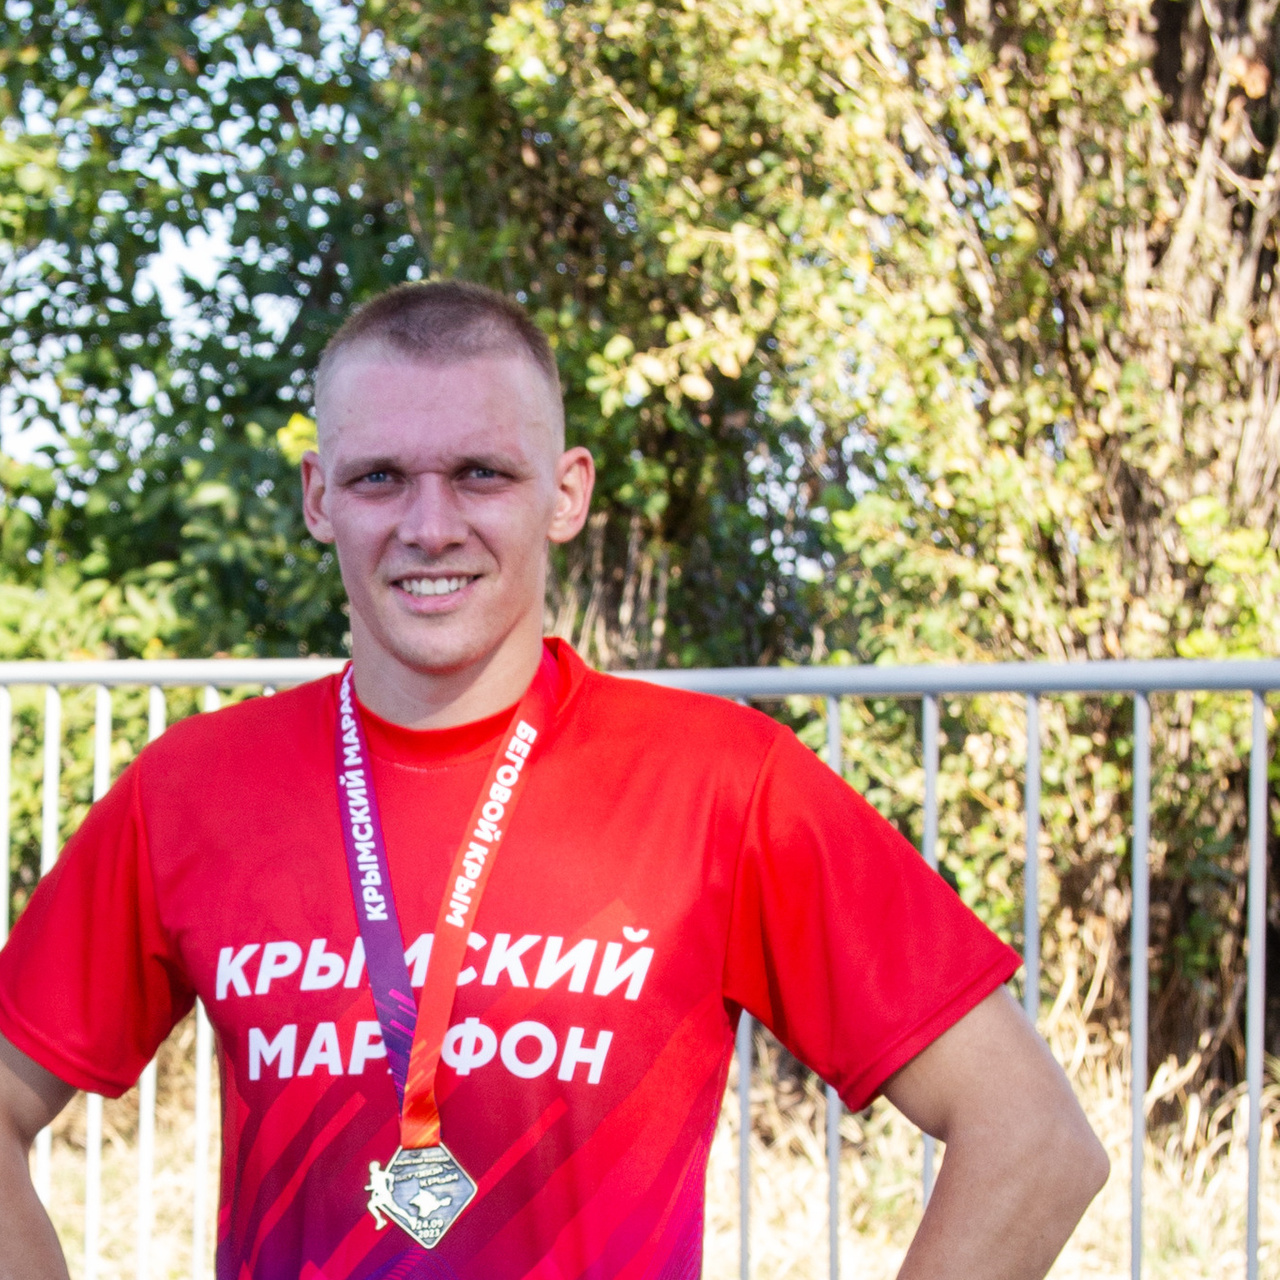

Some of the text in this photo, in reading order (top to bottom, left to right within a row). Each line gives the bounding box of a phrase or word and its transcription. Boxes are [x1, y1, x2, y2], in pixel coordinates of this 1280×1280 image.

[339, 769, 389, 921] КРЫМСКИЙ
[445, 719, 538, 929] БЕГОВОЙ КРЫМ
[247, 1017, 614, 1085] МАРФОН
